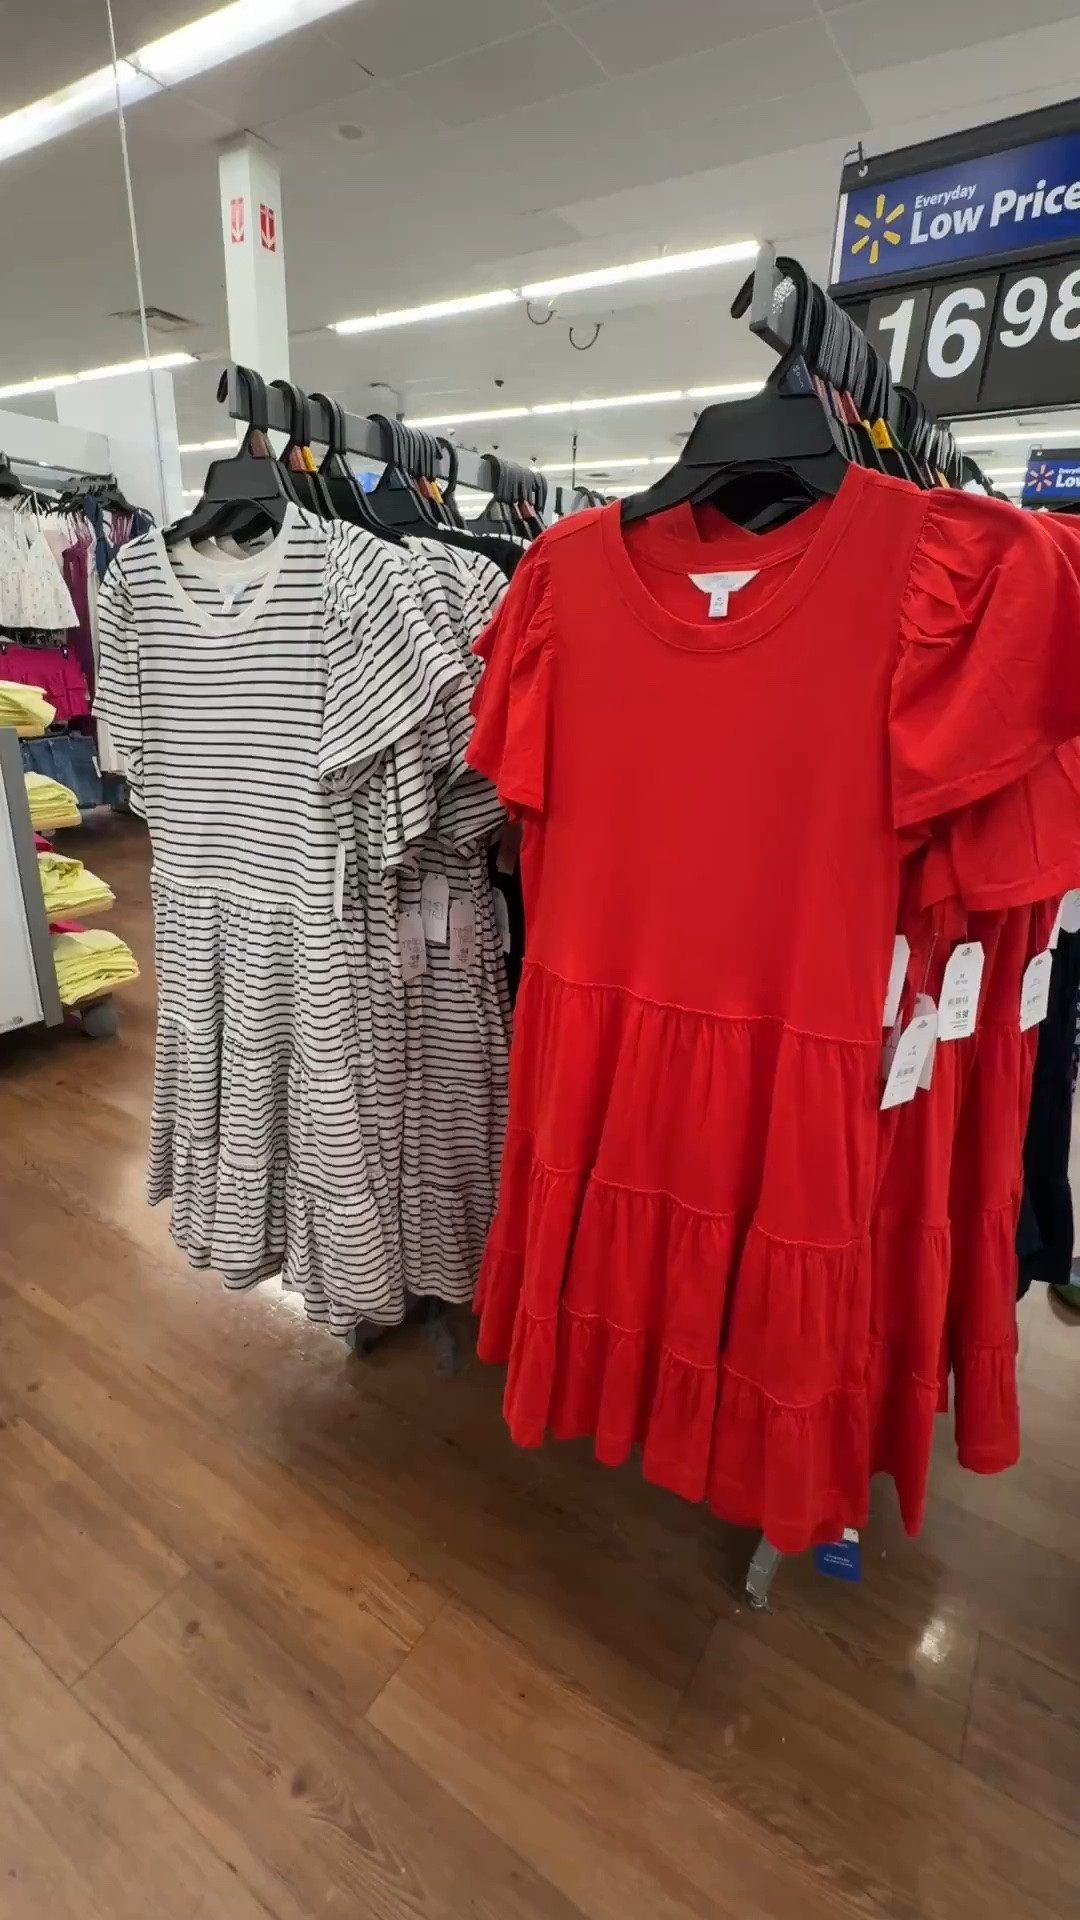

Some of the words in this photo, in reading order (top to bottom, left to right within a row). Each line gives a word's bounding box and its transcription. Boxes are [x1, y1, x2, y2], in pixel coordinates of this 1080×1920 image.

[915, 184, 977, 209] Everyday
[910, 205, 985, 245] Low
[990, 179, 1080, 227] Price
[1056, 473, 1080, 488] Lo
